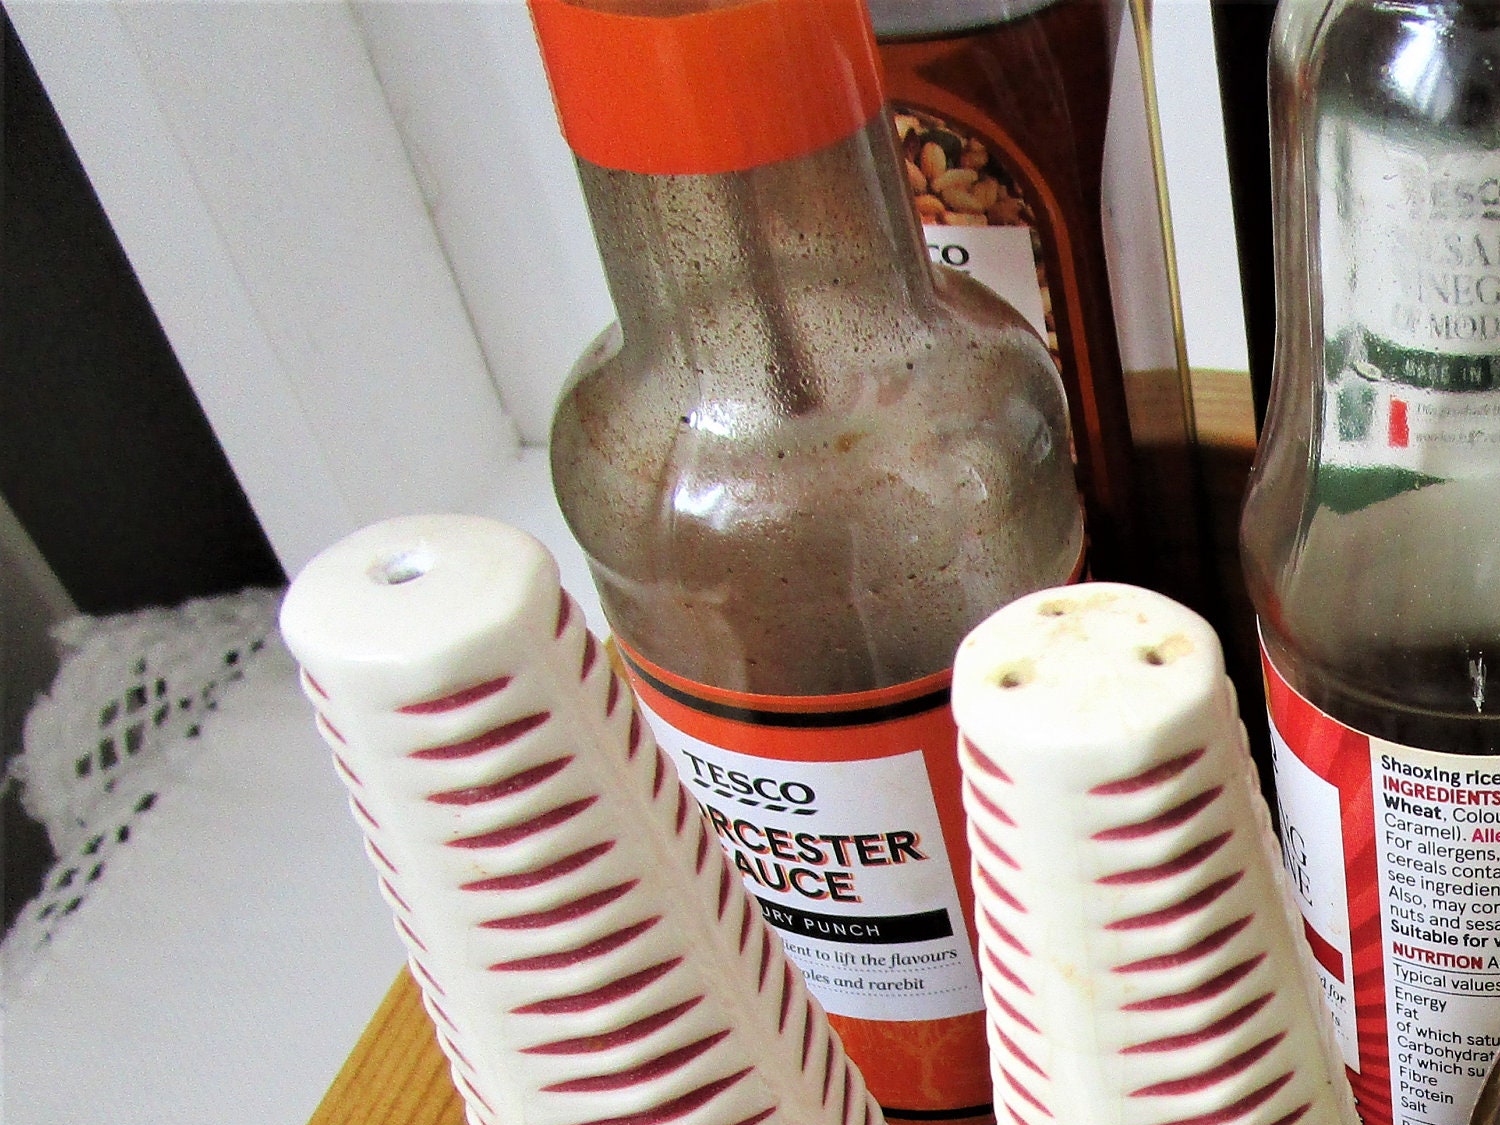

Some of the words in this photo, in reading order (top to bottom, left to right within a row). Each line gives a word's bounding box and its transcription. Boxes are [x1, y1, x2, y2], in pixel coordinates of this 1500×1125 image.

[682, 749, 816, 805] TESCO
[1381, 755, 1461, 787] Shaoxing
[1383, 794, 1447, 822] Wheat,
[1384, 813, 1467, 843] Caramel).
[1386, 831, 1413, 849] For
[1417, 840, 1500, 863] allergens,
[1387, 852, 1447, 876] cereals
[1388, 869, 1416, 887] see
[1388, 885, 1427, 908] Also,
[1432, 899, 1466, 915] may
[804, 918, 880, 937] PUNCH
[1390, 904, 1424, 923] nuts
[1430, 915, 1460, 930] and
[1391, 919, 1458, 946] Suitable
[1463, 934, 1489, 948] for
[782, 937, 812, 957] ient
[815, 949, 830, 961] to
[835, 952, 857, 965] lift
[861, 953, 886, 967] the
[889, 949, 958, 968] flavours
[1392, 941, 1483, 970] NUTRITION
[802, 968, 830, 985] oles
[834, 977, 864, 990] and
[868, 978, 925, 991] rarebit
[1394, 963, 1446, 989] Typical
[1395, 986, 1447, 1013] Energy
[1396, 1004, 1419, 1021] Fat
[1397, 1021, 1411, 1033] of
[1415, 1025, 1462, 1045] which
[1398, 1052, 1412, 1065] of
[1417, 1057, 1463, 1076] which
[1399, 1066, 1438, 1087] Fibre
[1400, 1081, 1454, 1105] Protein
[1401, 1097, 1427, 1114] Salt
